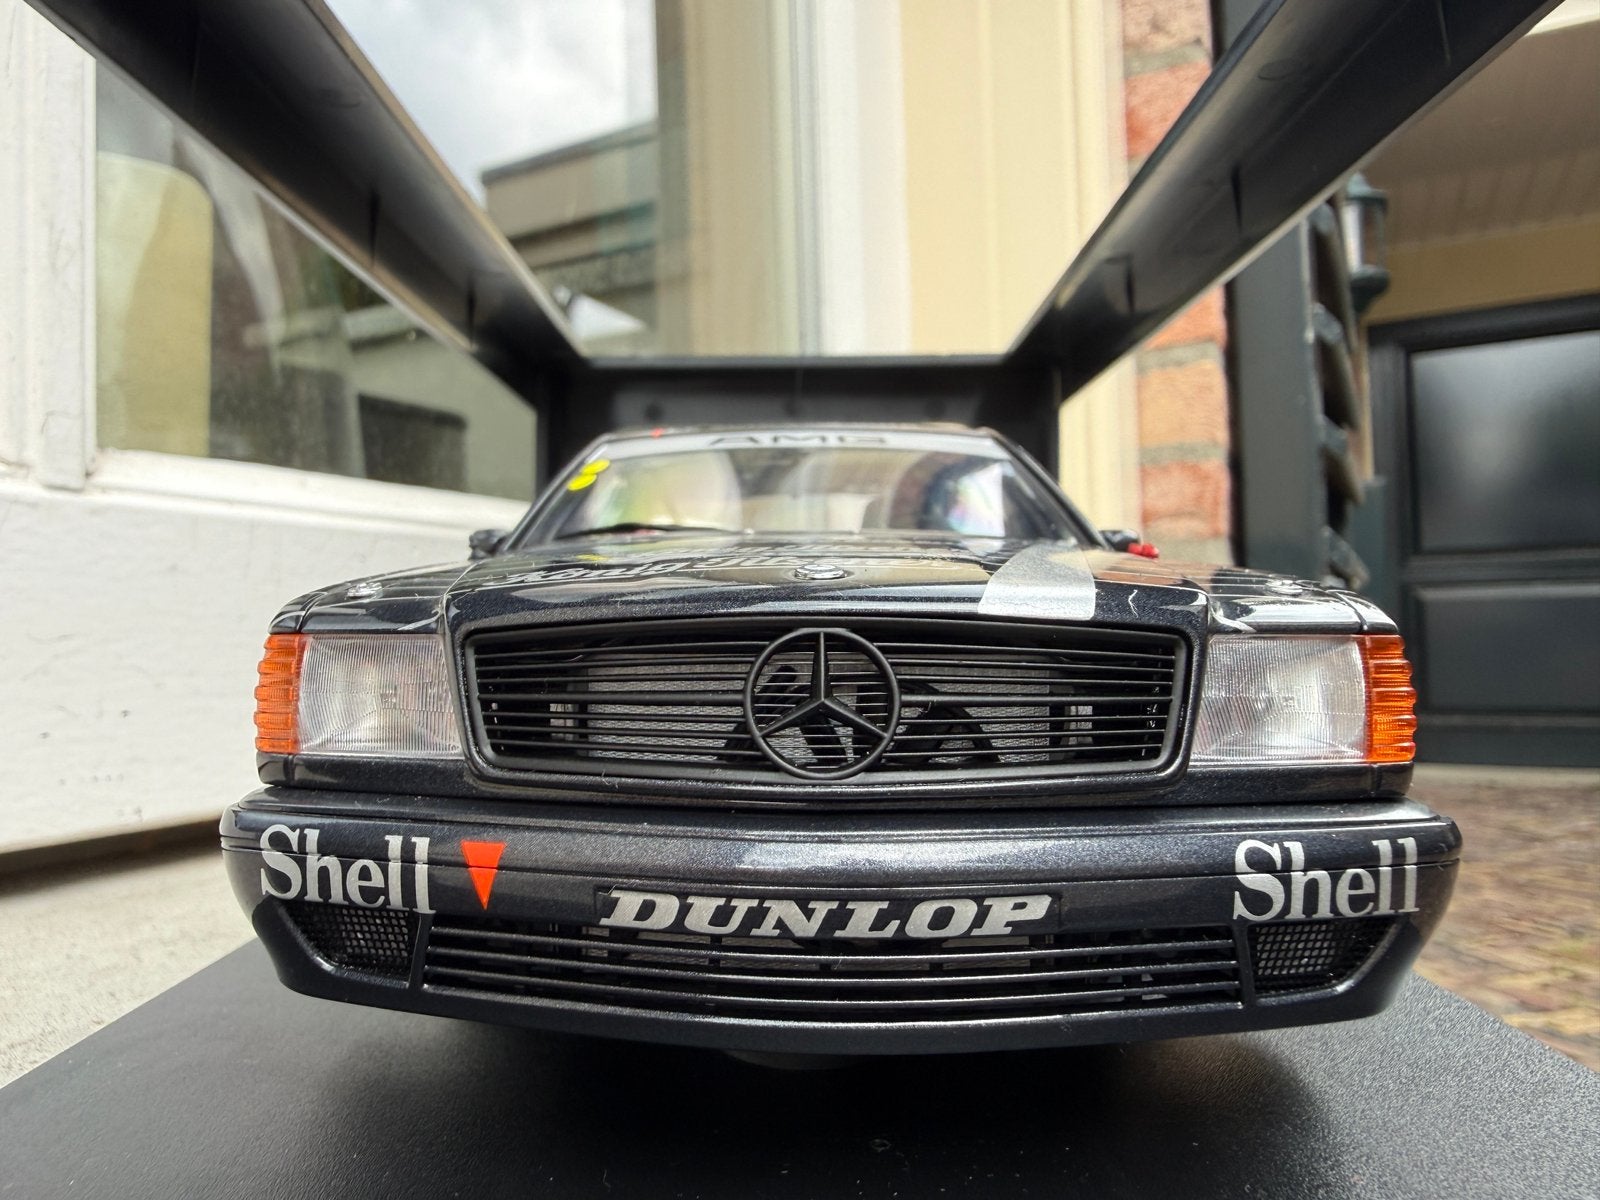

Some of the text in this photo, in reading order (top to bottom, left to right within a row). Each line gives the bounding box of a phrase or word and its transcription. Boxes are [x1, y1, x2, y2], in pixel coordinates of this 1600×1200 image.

[709, 434, 887, 446] AMG
[259, 824, 436, 915] Shell
[1232, 836, 1421, 922] Shell
[598, 888, 1054, 938] DUNLOP
